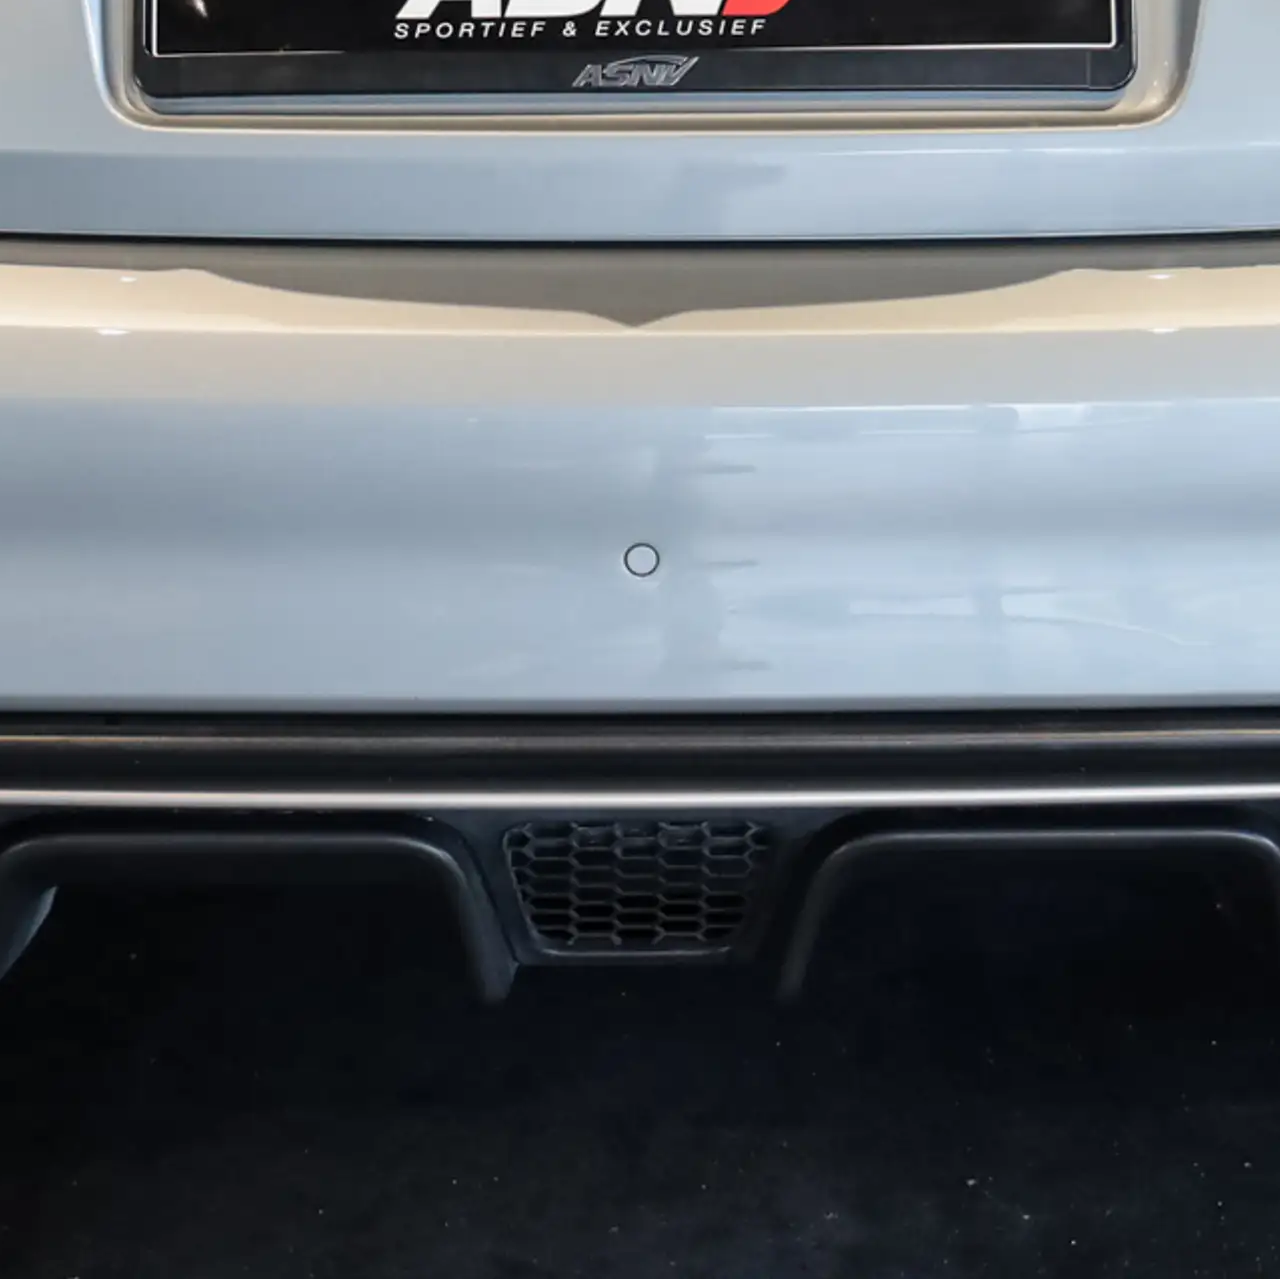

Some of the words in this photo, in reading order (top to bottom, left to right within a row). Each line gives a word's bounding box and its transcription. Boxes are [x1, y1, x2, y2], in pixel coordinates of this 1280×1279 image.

[394, 21, 546, 39] SPORTIEF
[563, 21, 577, 37] &
[595, 18, 767, 38] EXCLUSIEF
[572, 55, 699, 87] ASNV
